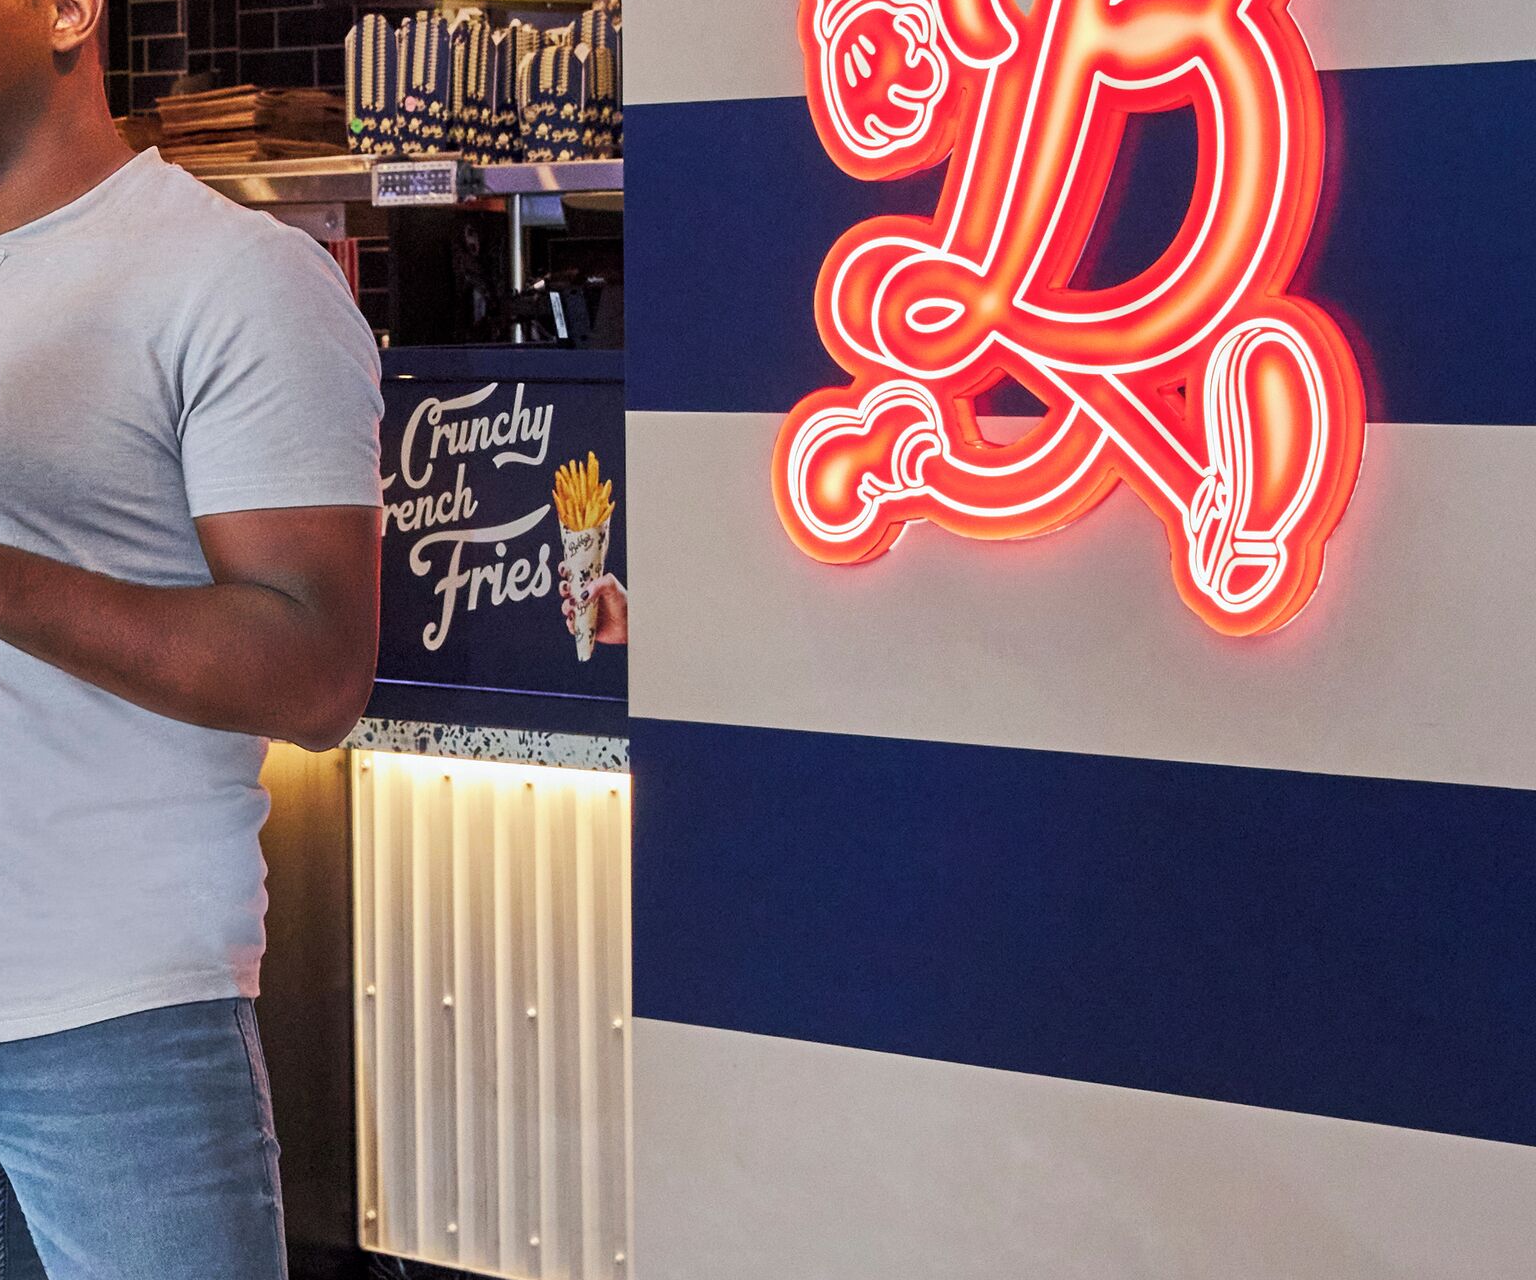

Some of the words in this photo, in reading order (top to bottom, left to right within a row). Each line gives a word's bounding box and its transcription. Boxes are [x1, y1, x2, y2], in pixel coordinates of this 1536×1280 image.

[401, 382, 554, 489] Crunchy
[380, 463, 479, 537] rench
[409, 504, 552, 652] Fries
